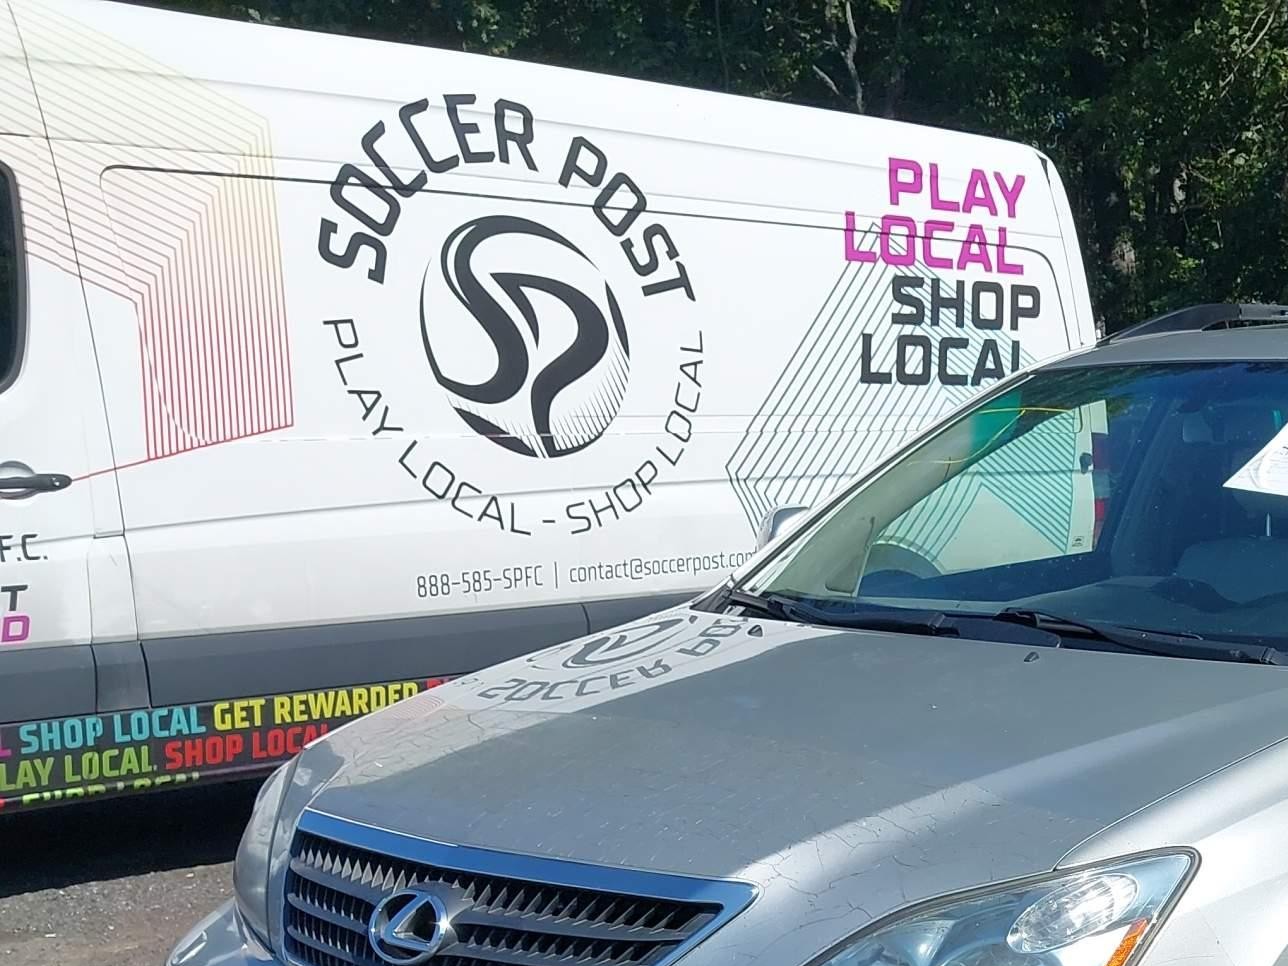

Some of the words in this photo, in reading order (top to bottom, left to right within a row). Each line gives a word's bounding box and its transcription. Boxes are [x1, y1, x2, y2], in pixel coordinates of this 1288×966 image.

[317, 93, 539, 284] SOCCER
[557, 135, 696, 302] POST
[888, 156, 1026, 219] PLAY
[843, 210, 1025, 275] LOCAL
[890, 274, 1041, 331] SHOP
[322, 317, 404, 436] PLAY
[398, 439, 532, 536] LOCAL
[565, 459, 659, 536] SHOP
[655, 329, 704, 467] LOCAL
[416, 563, 544, 598] 888-585-SPFC
[19, 714, 103, 754] SHOP
[113, 704, 207, 743] LOCAL
[213, 697, 266, 731] GET
[273, 682, 419, 724] REWARDED
[164, 734, 244, 770] SHOP
